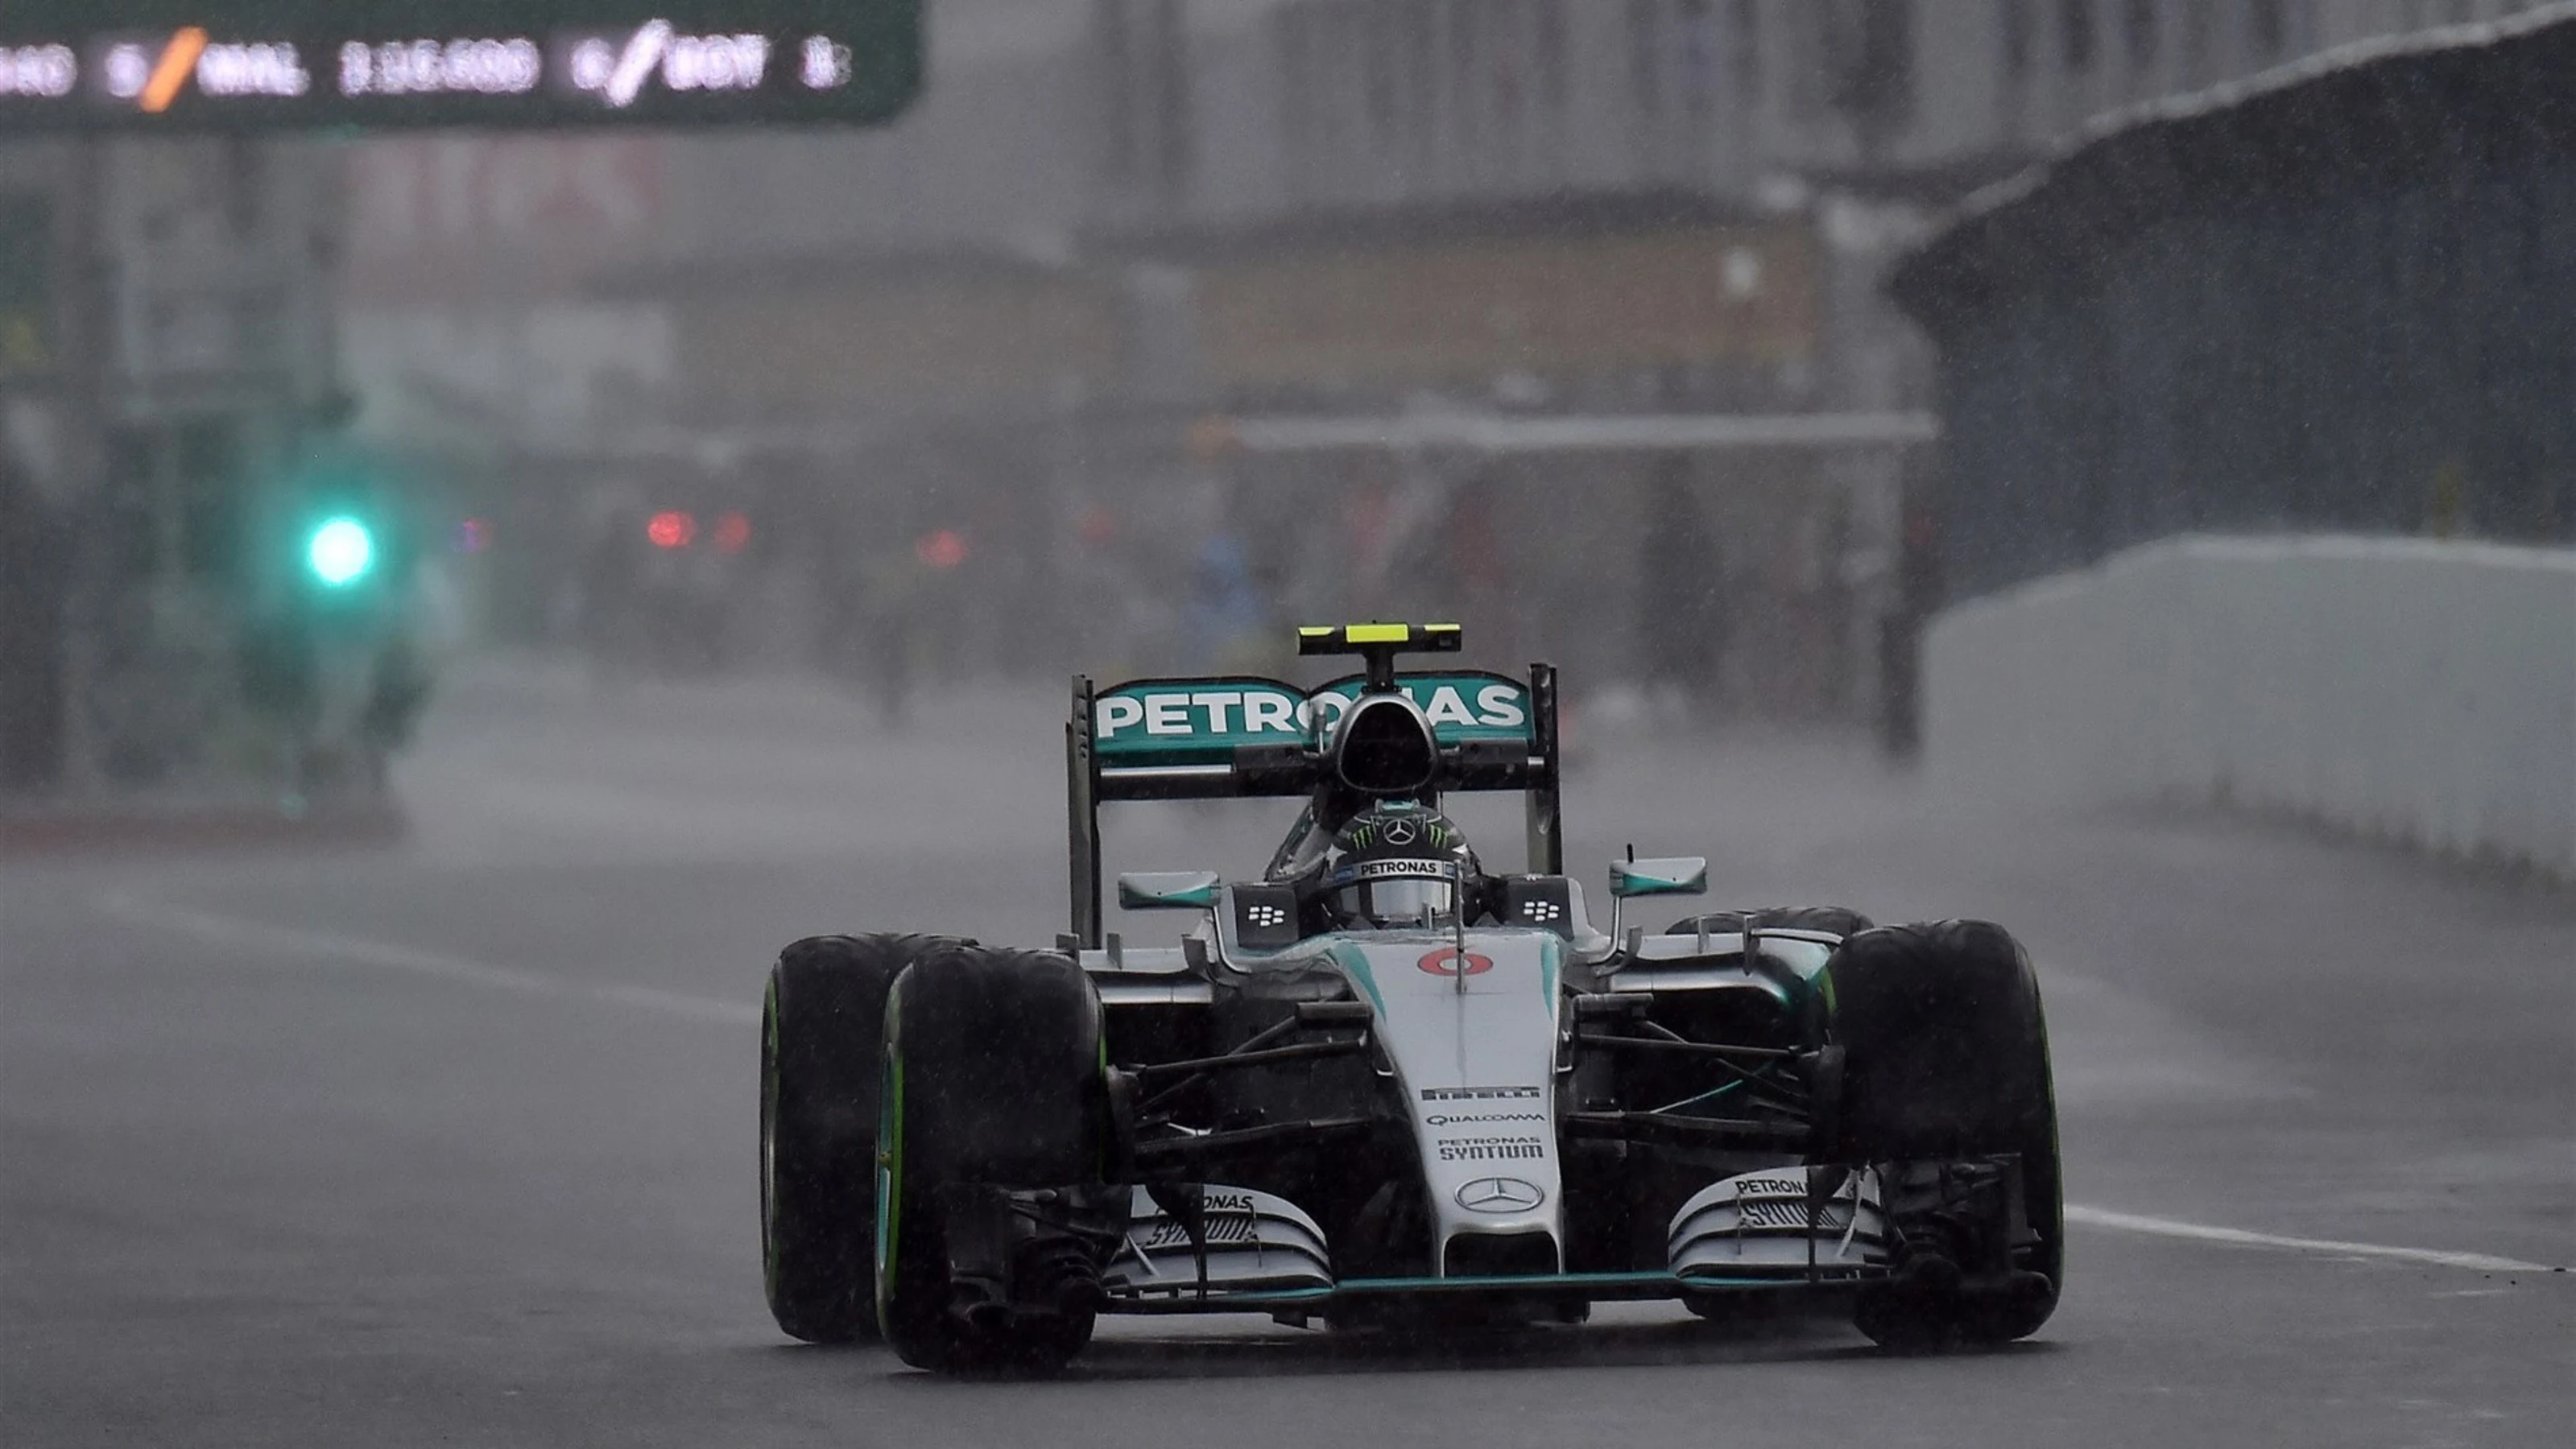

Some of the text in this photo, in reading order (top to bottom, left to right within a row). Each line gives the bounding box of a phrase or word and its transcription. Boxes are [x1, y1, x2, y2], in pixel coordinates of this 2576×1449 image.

[1096, 686, 1524, 738] PETROAS
[1361, 861, 1437, 876] PETRONAS
[1421, 1087, 1540, 1100] PIRELLI
[1426, 1113, 1545, 1126] QUALCOMM
[1437, 1137, 1541, 1146] PETRONAS
[1440, 1145, 1544, 1161] SYNTIUM
[1735, 1179, 1805, 1195] PETRON
